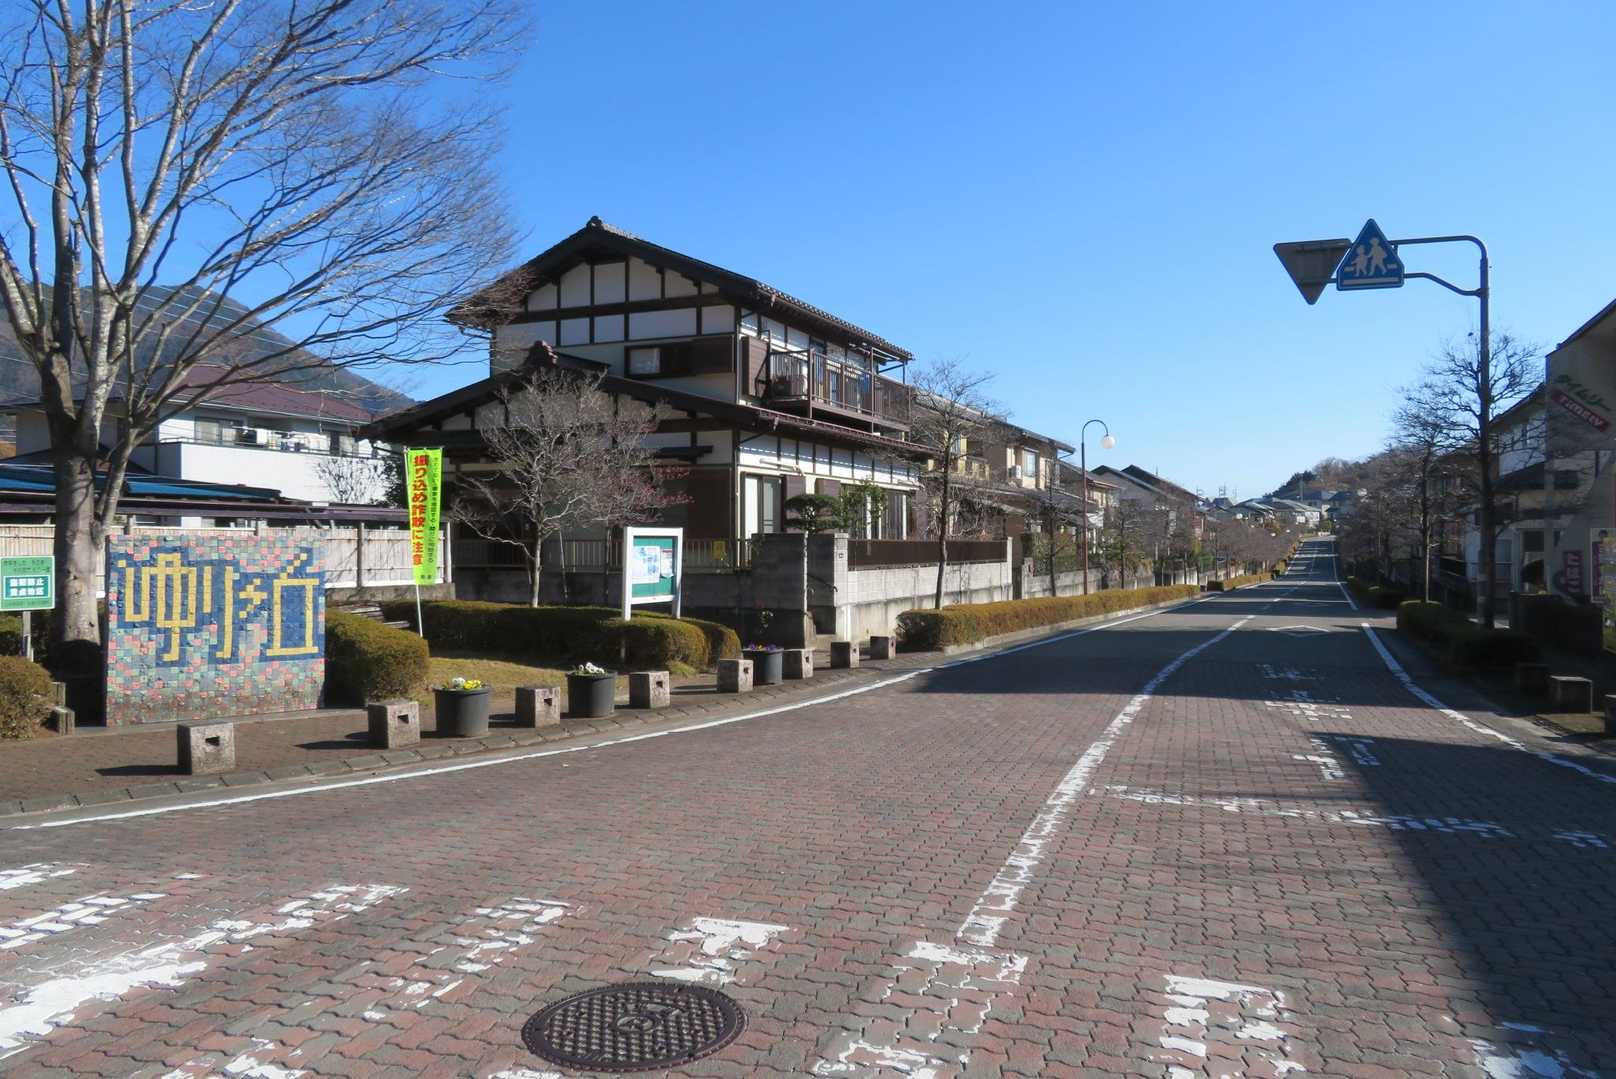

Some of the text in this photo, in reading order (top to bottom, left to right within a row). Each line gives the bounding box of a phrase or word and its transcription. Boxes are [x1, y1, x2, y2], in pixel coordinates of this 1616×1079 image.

[411, 454, 429, 566] 振り込め詐欺に注意
